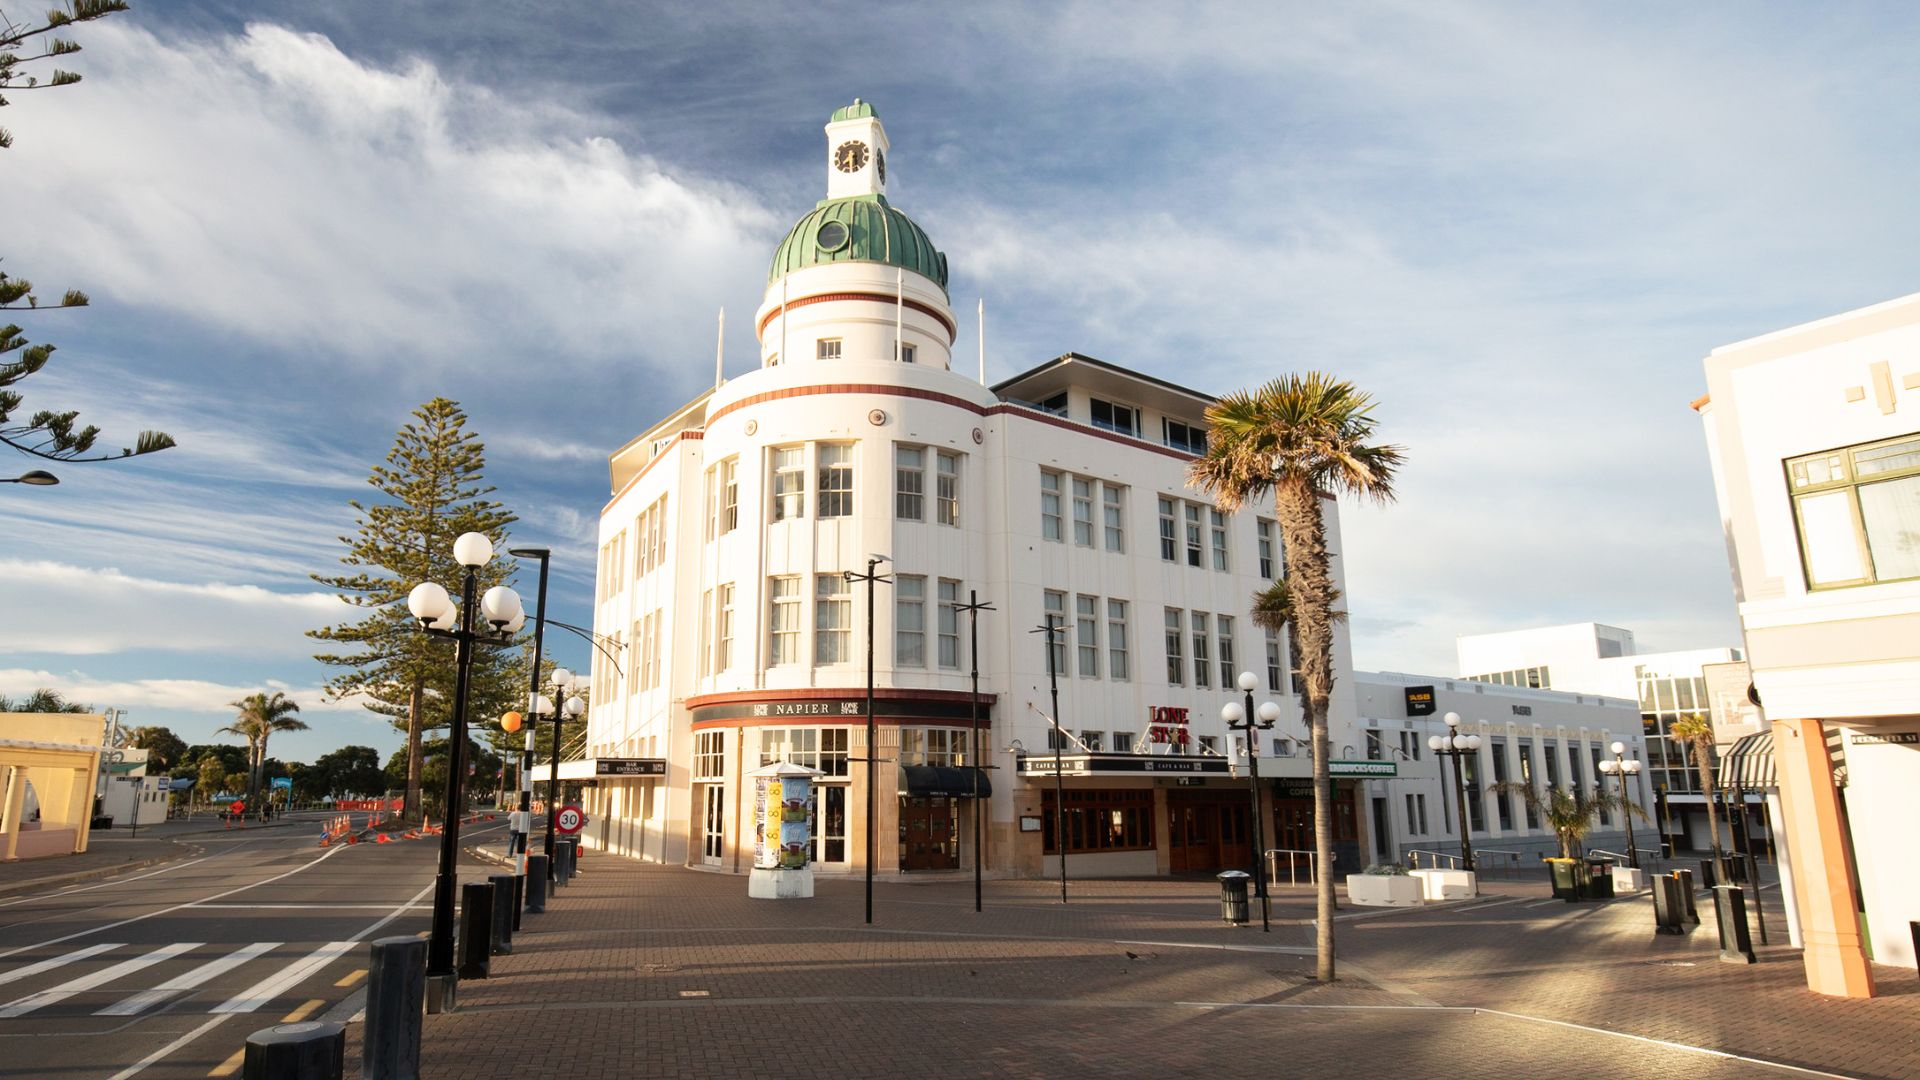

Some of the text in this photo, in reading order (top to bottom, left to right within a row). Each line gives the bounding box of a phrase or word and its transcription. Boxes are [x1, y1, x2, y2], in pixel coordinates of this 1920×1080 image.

[1409, 693, 1430, 701] ASB
[776, 703, 829, 714] NAPIER
[1149, 706, 1189, 724] LONE
[1368, 764, 1395, 773] COFFEE
[1289, 788, 1315, 796] COFFE
[561, 814, 577, 825] 30
